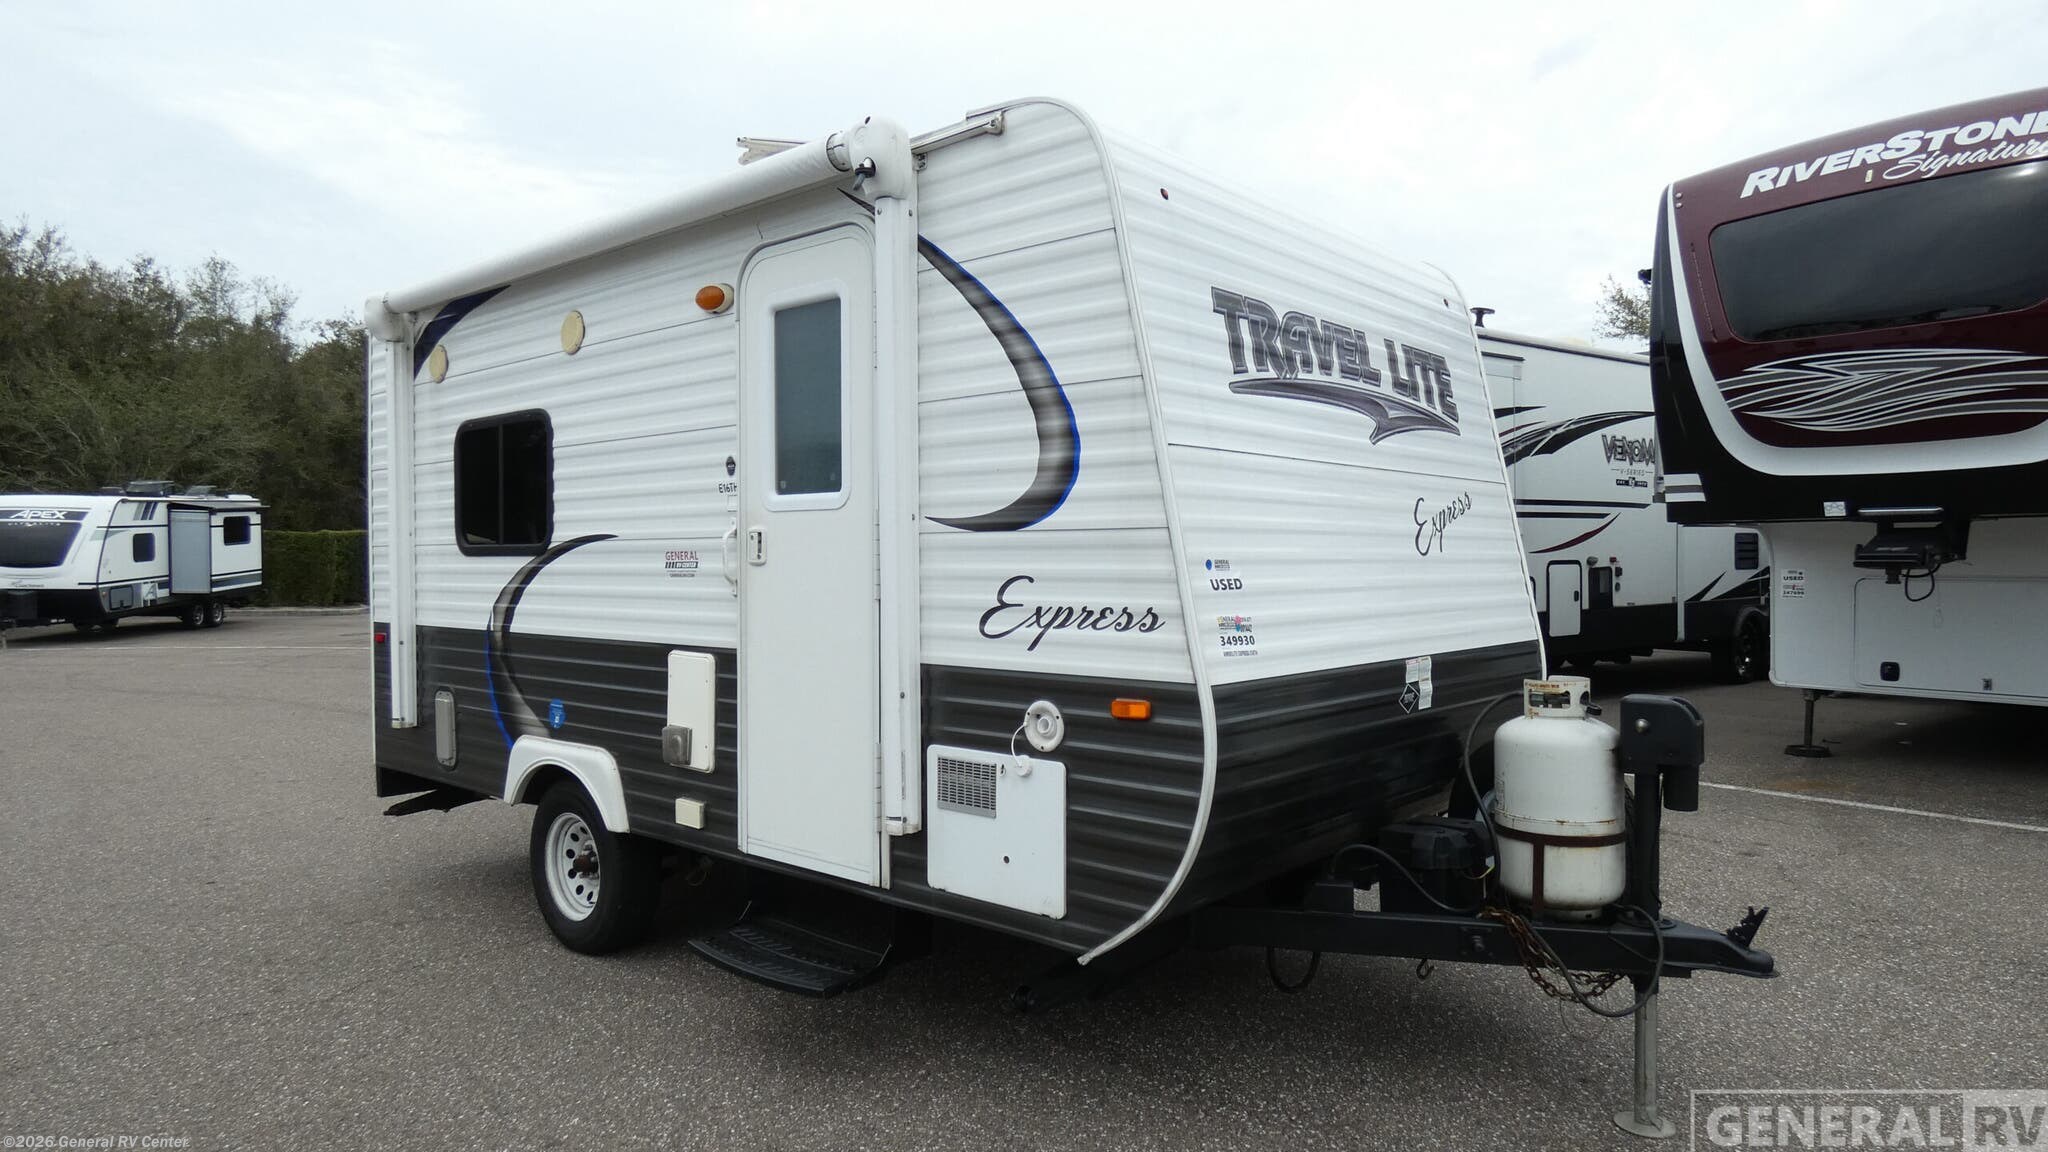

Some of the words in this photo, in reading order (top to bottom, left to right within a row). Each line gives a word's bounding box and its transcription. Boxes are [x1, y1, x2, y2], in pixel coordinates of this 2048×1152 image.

[1211, 286, 1382, 387] TRAVEL
[1384, 337, 1459, 423] LITE
[1601, 434, 1655, 466] VENOM
[9, 510, 68, 520] APEX
[1413, 491, 1472, 556] Express
[665, 551, 699, 561] GENERAL
[1209, 578, 1243, 591] USED
[979, 575, 1166, 651] Express
[1219, 635, 1256, 647] 349930
